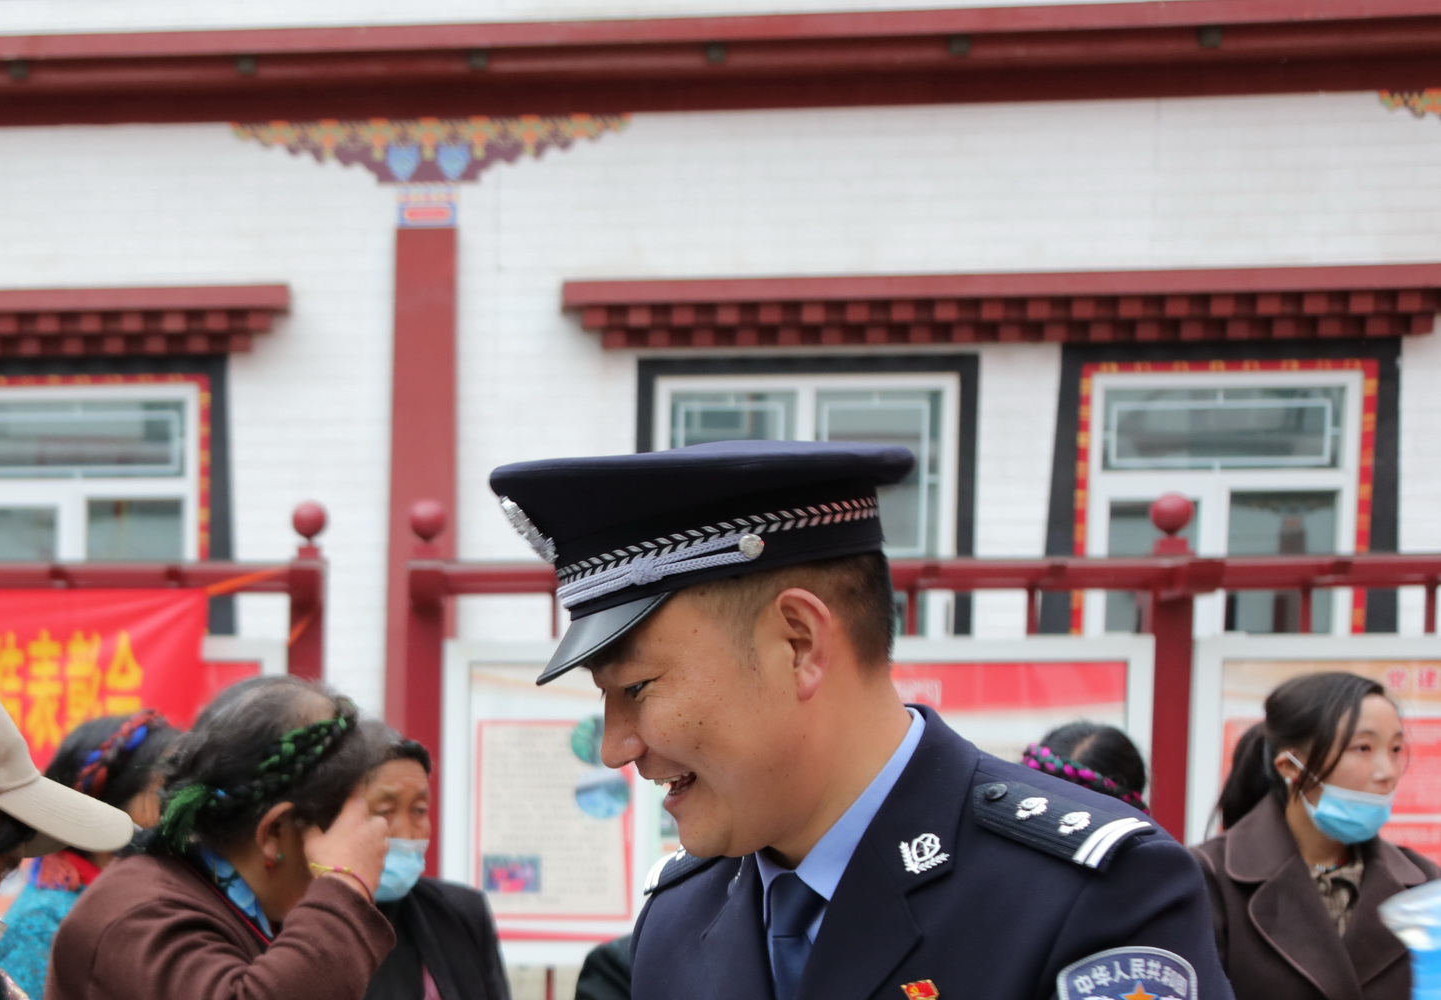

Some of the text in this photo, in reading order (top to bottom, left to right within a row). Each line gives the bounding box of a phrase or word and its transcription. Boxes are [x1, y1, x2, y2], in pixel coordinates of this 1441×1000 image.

[1073, 957, 1188, 998] 中华人民共和国
